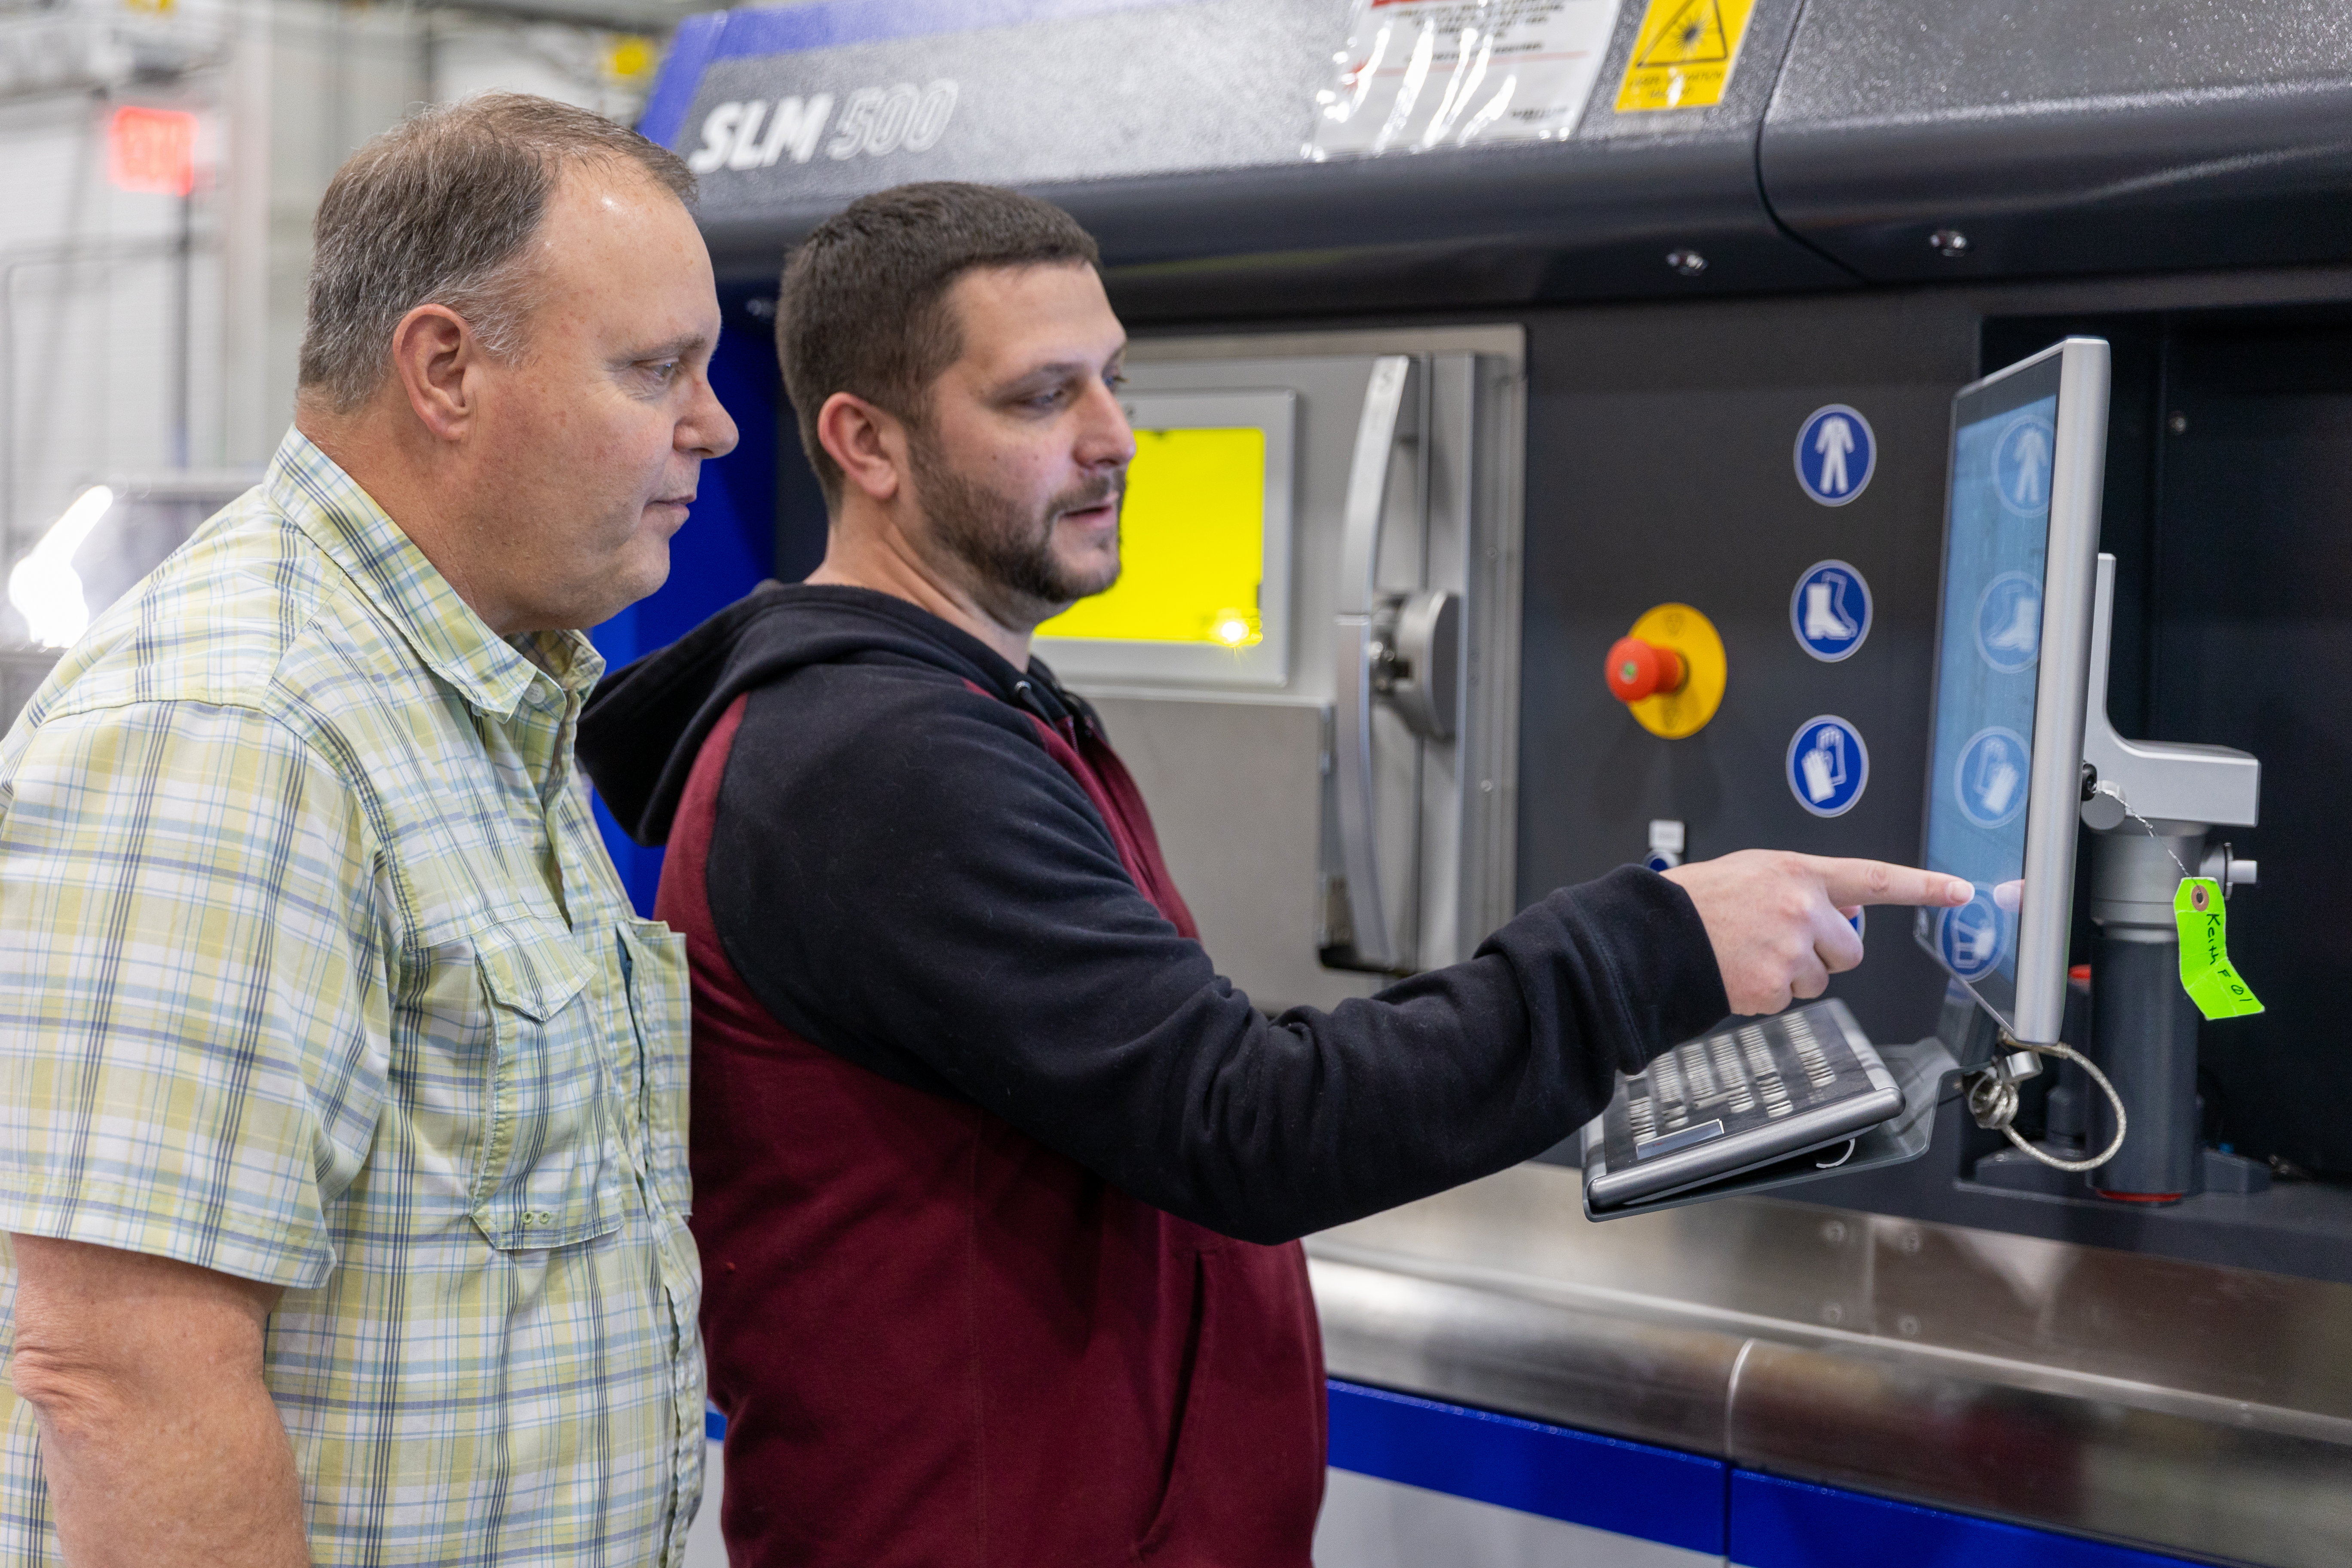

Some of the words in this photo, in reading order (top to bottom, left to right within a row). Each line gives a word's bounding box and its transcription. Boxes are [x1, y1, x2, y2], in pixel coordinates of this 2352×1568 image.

[689, 92, 834, 173] SLM
[826, 79, 958, 160] 500
[2206, 913, 2221, 965] Keith
